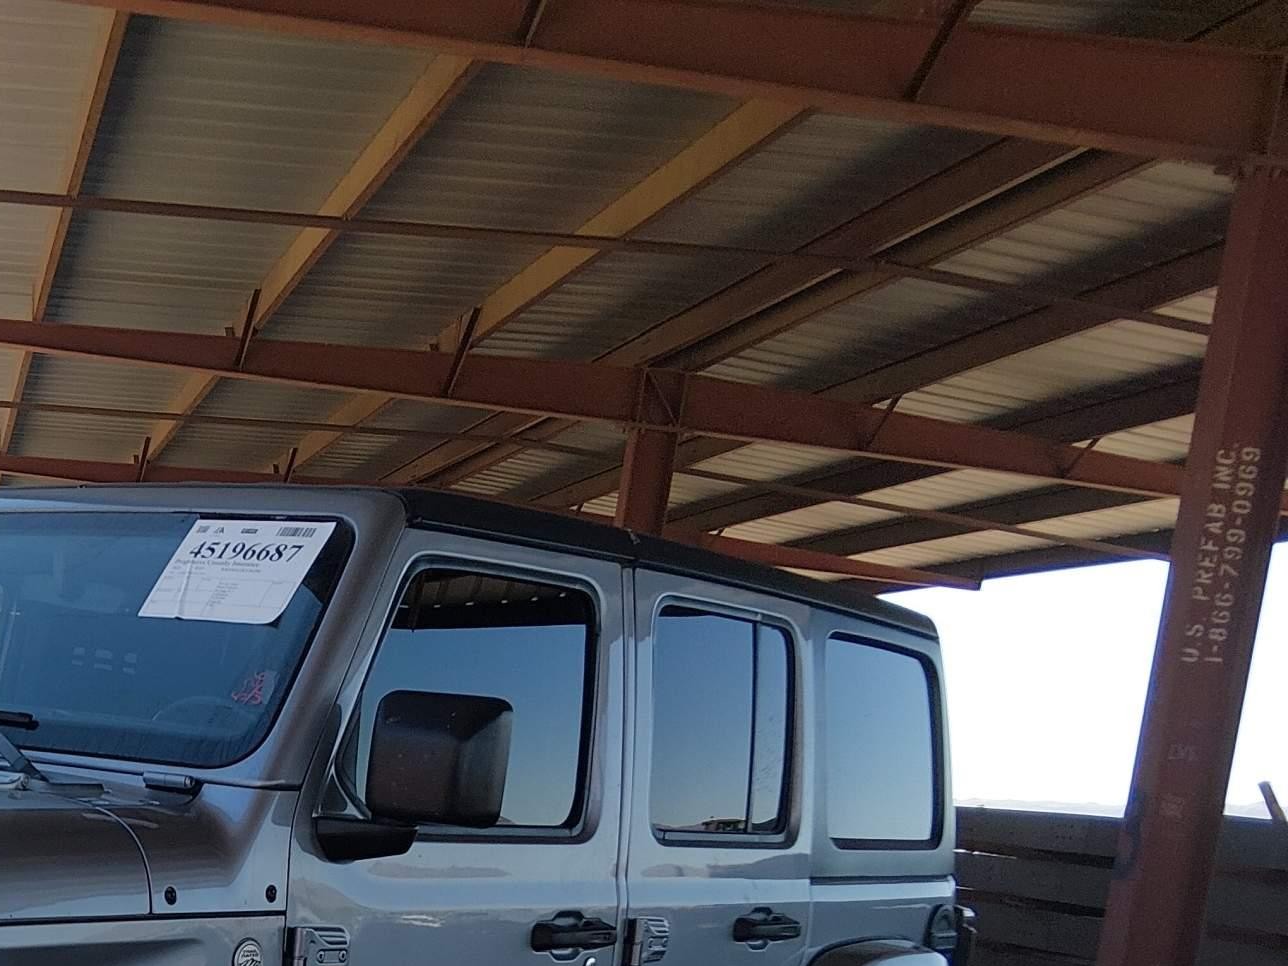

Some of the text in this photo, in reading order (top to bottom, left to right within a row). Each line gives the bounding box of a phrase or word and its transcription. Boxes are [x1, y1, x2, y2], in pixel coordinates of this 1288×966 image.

[189, 540, 305, 563] 45196687
[1192, 503, 1226, 600] PREFAB
[1212, 443, 1240, 489] INC.
[1203, 446, 1261, 662] 1-866-799-0969
